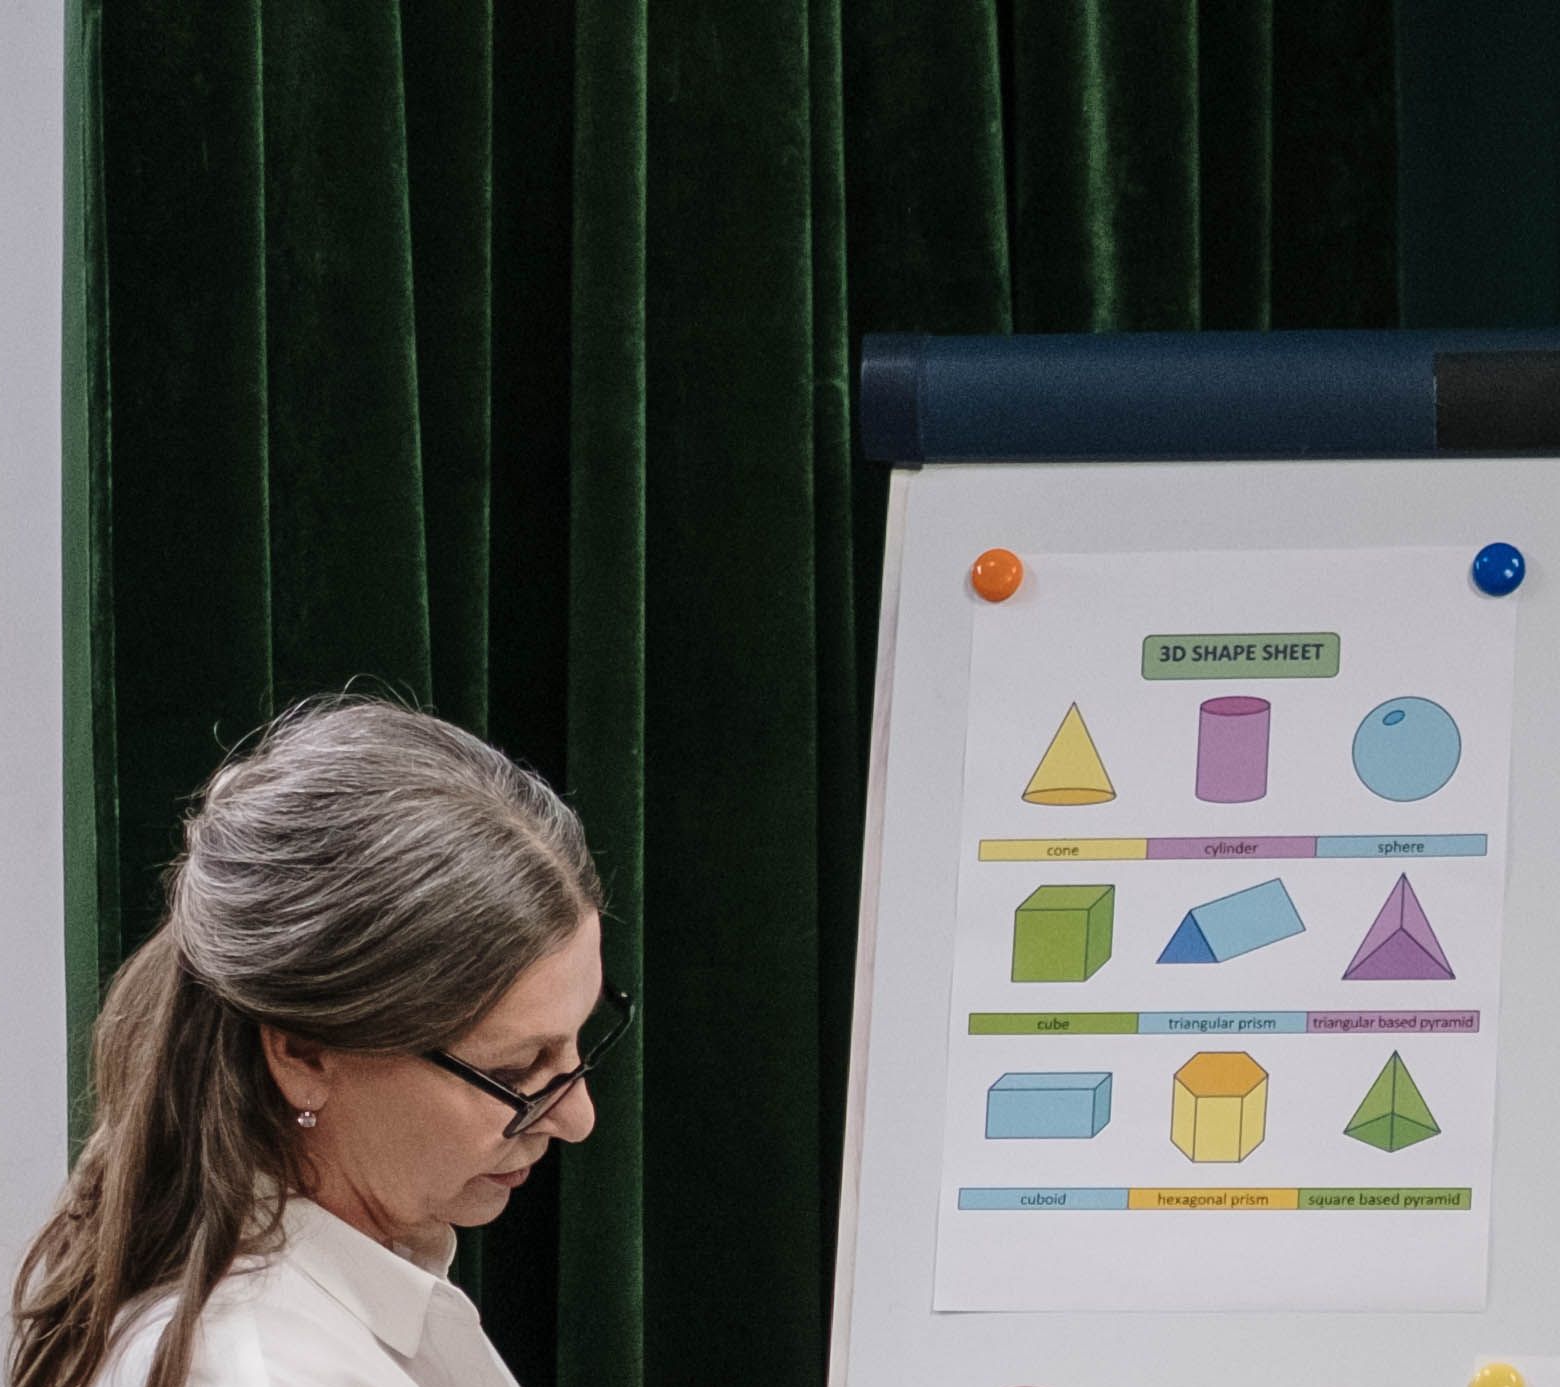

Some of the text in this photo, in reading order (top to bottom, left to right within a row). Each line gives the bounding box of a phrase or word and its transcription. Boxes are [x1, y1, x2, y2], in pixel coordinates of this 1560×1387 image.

[1159, 643, 1324, 662] 3D SHAPE SHEET
[1047, 845, 1079, 857] cone
[1204, 841, 1258, 856] cylinder
[1378, 840, 1424, 855] sphere
[1037, 1018, 1069, 1030] cube
[1168, 1017, 1276, 1033] triangular prism
[1314, 1015, 1473, 1030] triangular based pyramid
[1020, 1193, 1066, 1206] cuboid
[1158, 1192, 1268, 1208] hexagonal prism
[1309, 1193, 1460, 1208] square based pyramid
